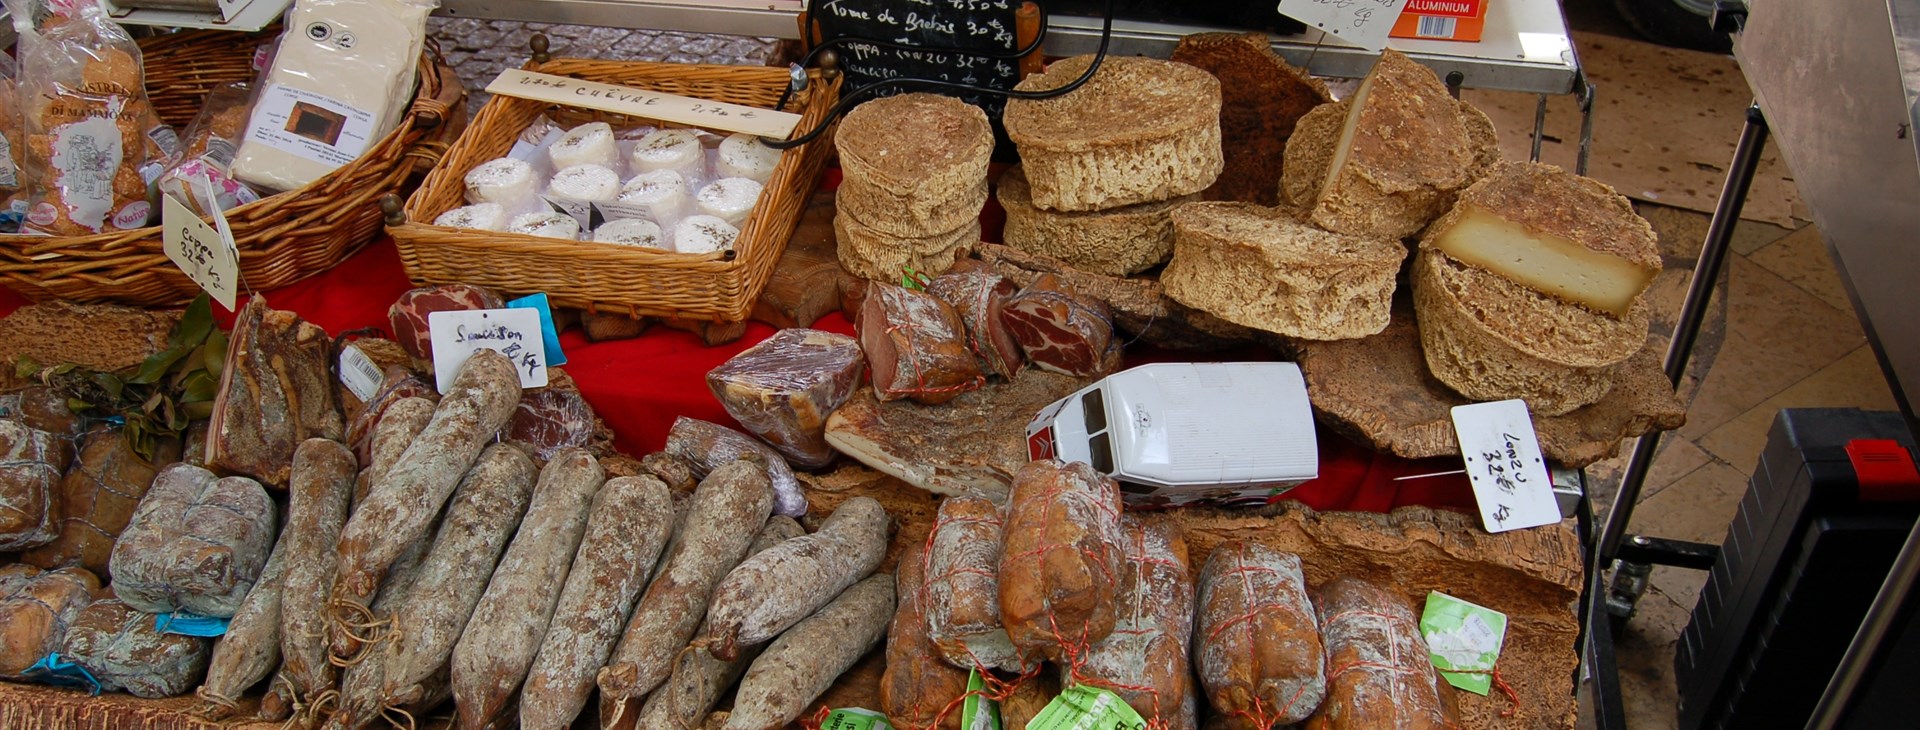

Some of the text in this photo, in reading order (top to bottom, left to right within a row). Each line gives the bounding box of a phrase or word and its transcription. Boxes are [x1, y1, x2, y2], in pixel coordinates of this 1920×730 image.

[823, 1, 871, 20] Tome
[877, 9, 899, 25] de
[1408, 0, 1470, 13] ALUMINIUM
